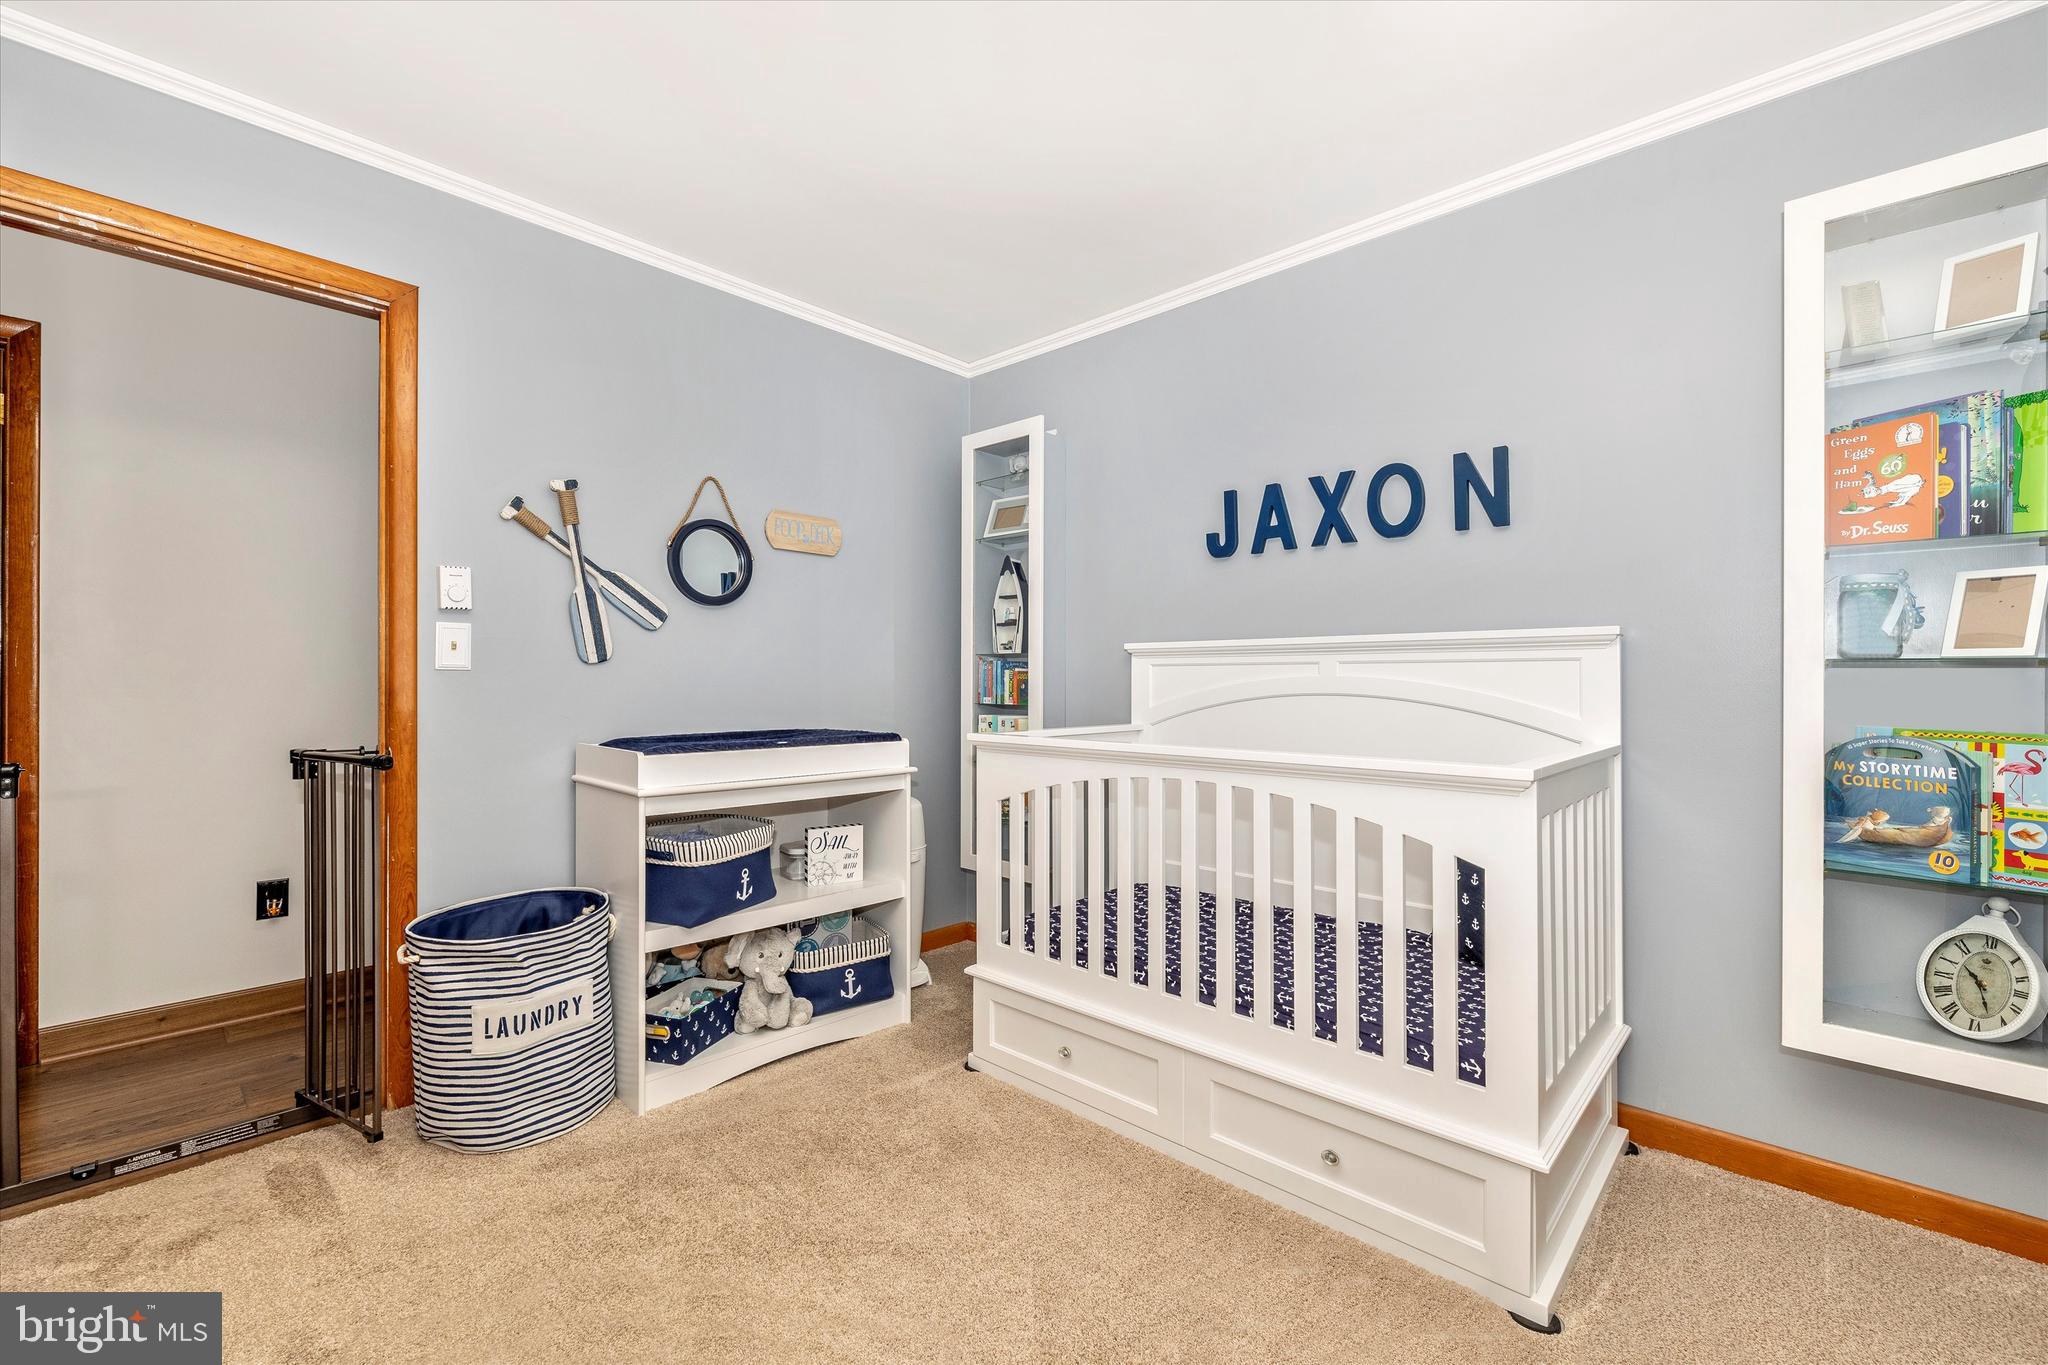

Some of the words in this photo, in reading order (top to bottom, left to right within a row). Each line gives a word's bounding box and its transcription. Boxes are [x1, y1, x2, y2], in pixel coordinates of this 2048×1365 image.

[1831, 435, 1868, 447] Green
[1844, 447, 1876, 461] Eggs
[1834, 465, 1857, 476] and
[1835, 480, 1862, 489] Ham
[1205, 445, 1511, 559] JAXON
[1850, 525, 1872, 539] Dr.
[1872, 521, 1909, 535] Seuss
[1833, 760, 1855, 773] My
[1860, 761, 1958, 780] STORYTIME
[1842, 774, 1948, 795] COLLECTION
[1935, 853, 1956, 869] 10
[484, 995, 583, 1040] LAUNDRY
